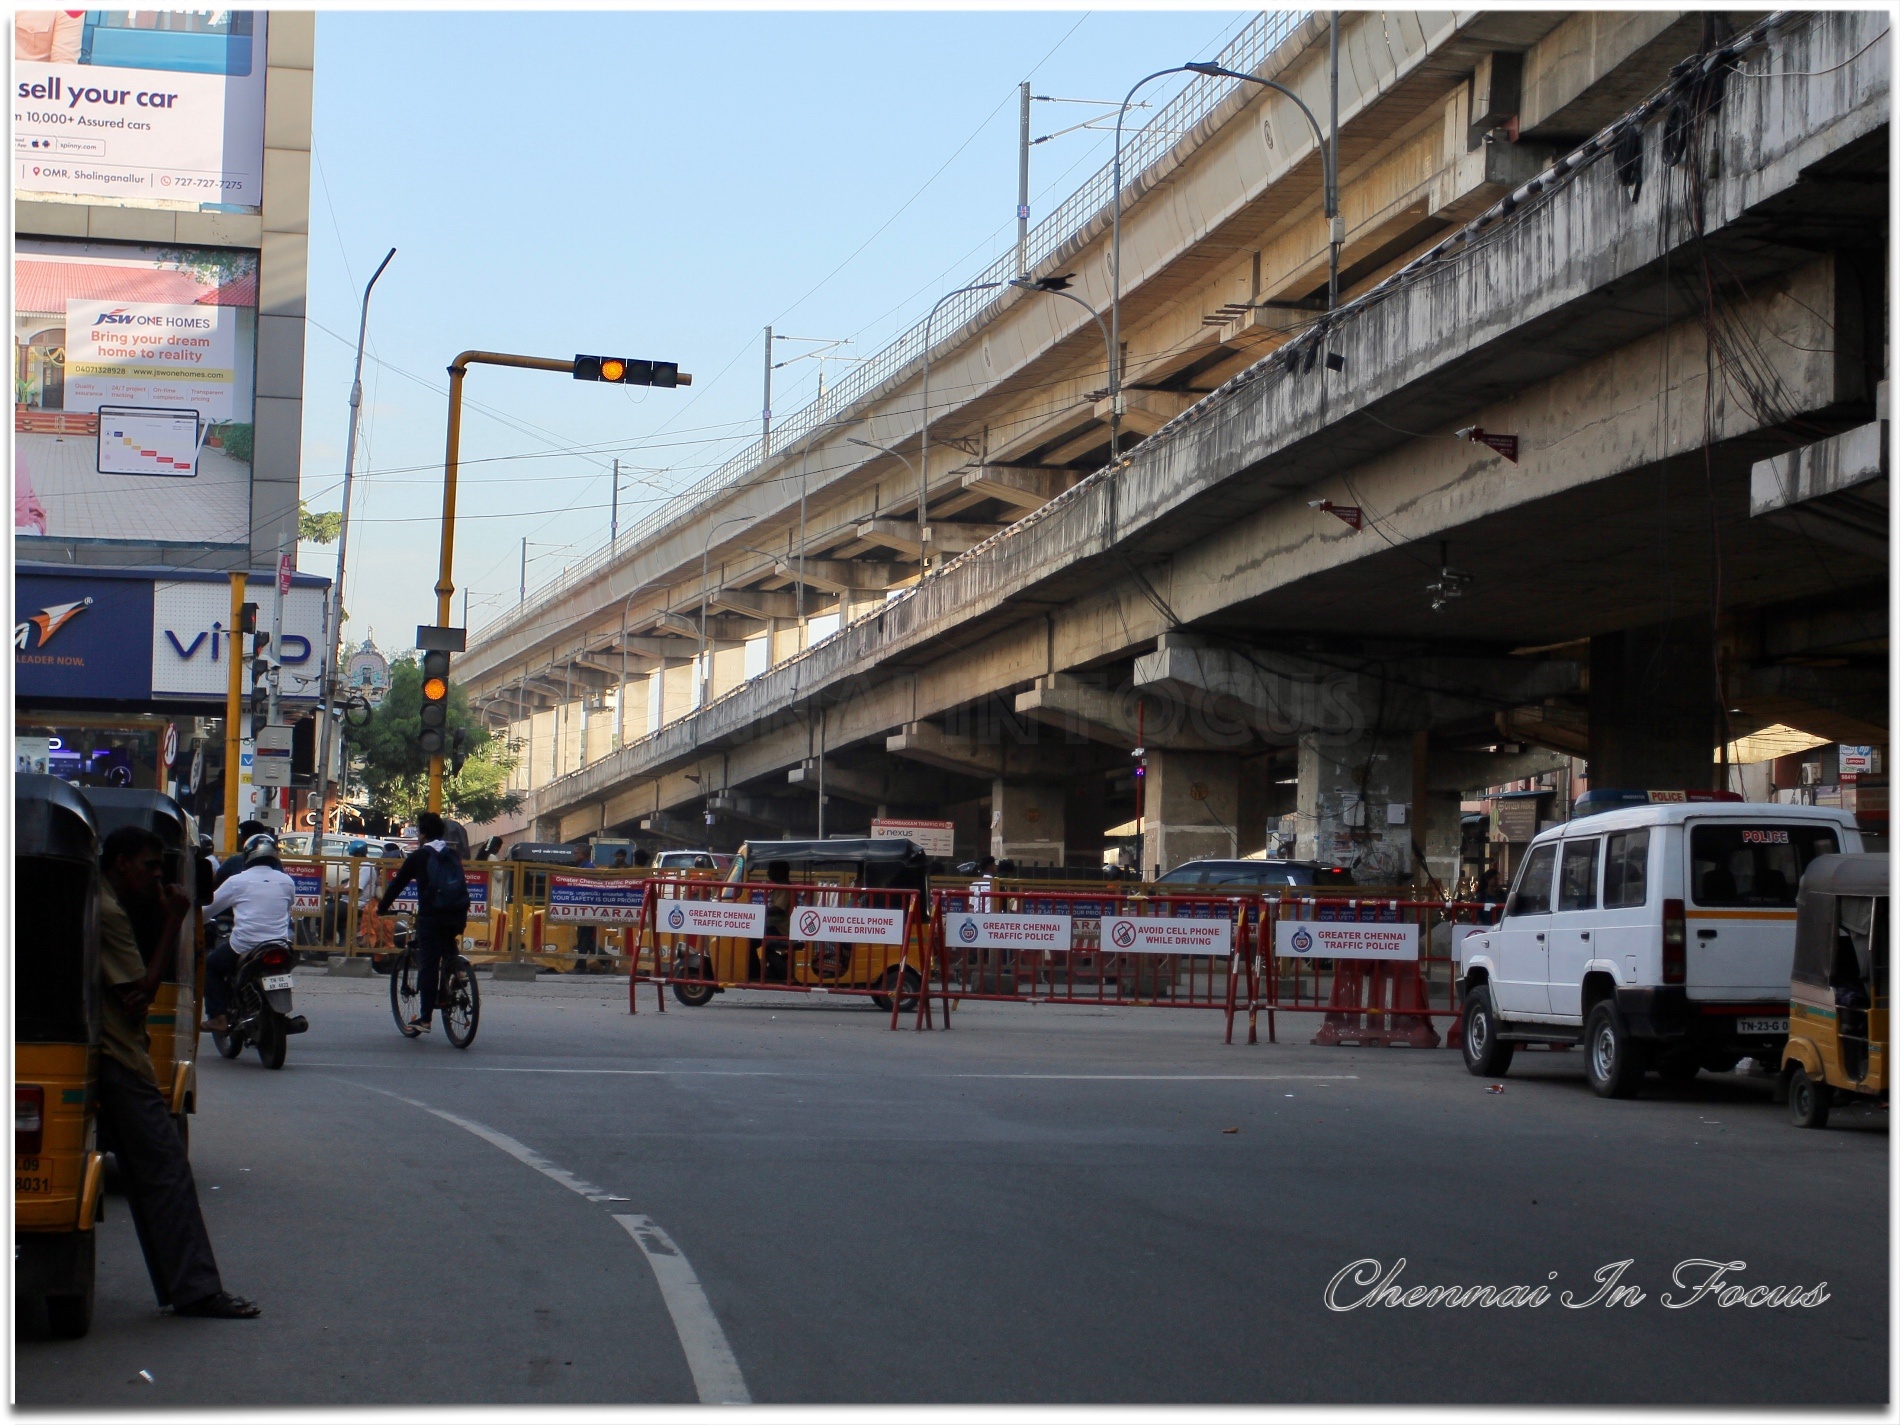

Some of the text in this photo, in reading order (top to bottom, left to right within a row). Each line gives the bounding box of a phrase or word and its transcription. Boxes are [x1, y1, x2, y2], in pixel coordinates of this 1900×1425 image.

[18, 76, 178, 108] sell your car
[27, 112, 74, 124] 10,000+
[78, 116, 124, 128] Assured
[128, 120, 151, 130] cars
[60, 142, 97, 150] spinny.com
[43, 168, 144, 184] OMR, Sholinganallur
[174, 177, 242, 190] 727-727-7275
[91, 313, 210, 328] JSW ONE HOMES
[91, 330, 210, 347] Bring your dream
[98, 346, 203, 363] home to reality
[134, 368, 224, 379] www.jswonehomes.com
[164, 622, 312, 664] vio
[16, 654, 84, 666] LEADER NOW.
[1652, 792, 1682, 801] POLICE
[1742, 830, 1789, 844] POLICE
[688, 909, 756, 920] GREATER CHENNAI
[692, 918, 750, 929] TRAFFIC POLICE
[822, 916, 844, 924] AVOID
[867, 918, 894, 926] PHONE
[983, 922, 1060, 931] GREATER CHENNAI
[828, 925, 886, 935] WHILE DRIVING
[1138, 927, 1164, 935] AVOID
[1318, 931, 1406, 940] GREATER CHENNAI
[988, 932, 1054, 941] TRAFFIC POLICE
[1146, 936, 1172, 944] WHILE
[1324, 941, 1400, 950] TRAFFIC POLICE
[1741, 1022, 1779, 1031] TN-23-G
